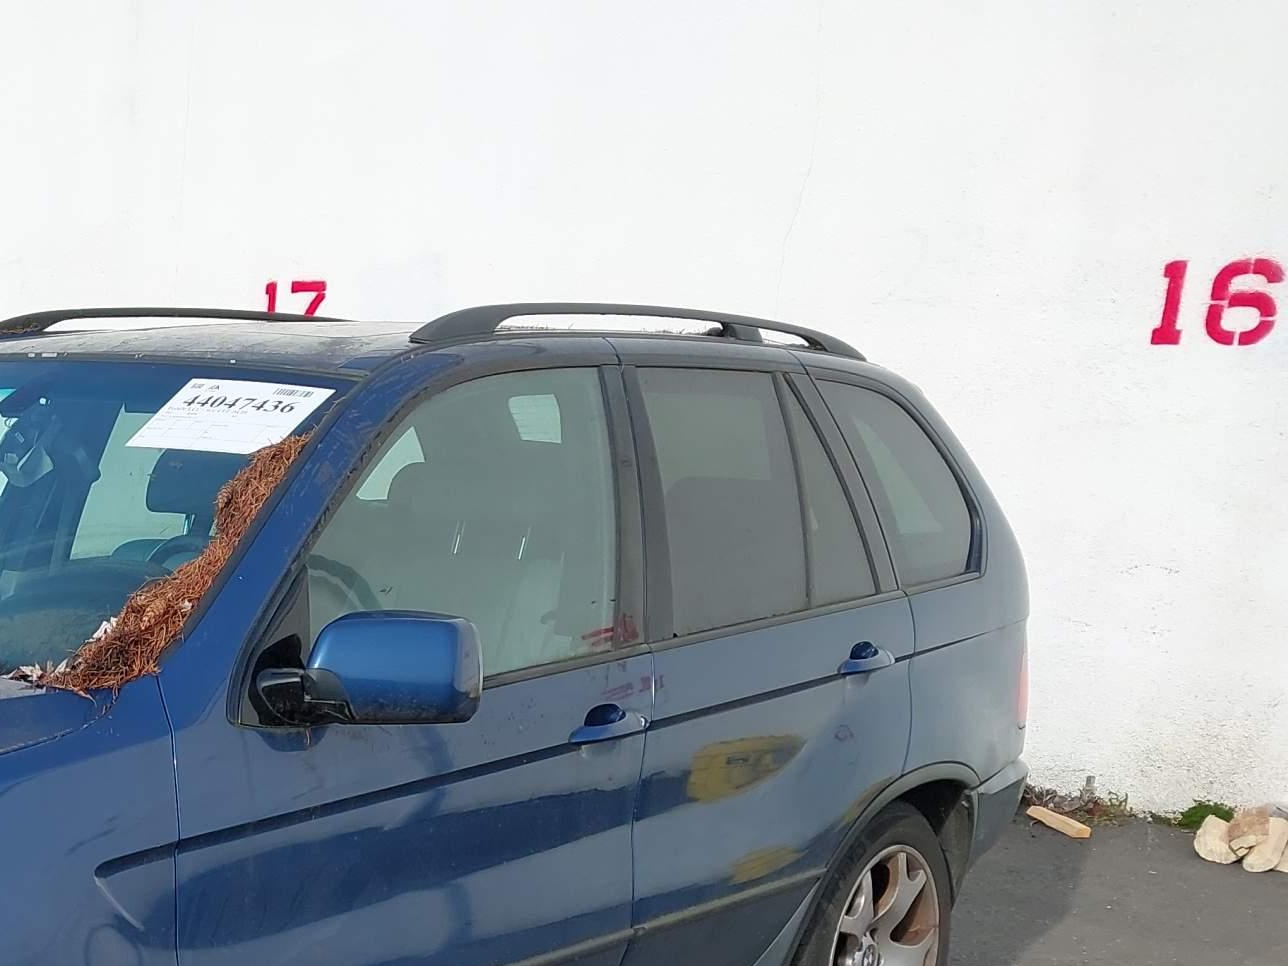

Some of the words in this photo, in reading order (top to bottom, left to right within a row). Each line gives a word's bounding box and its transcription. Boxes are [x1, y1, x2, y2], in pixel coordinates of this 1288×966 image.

[265, 280, 327, 317] 17
[1150, 257, 1286, 346] 16
[183, 394, 303, 414] 44047436
